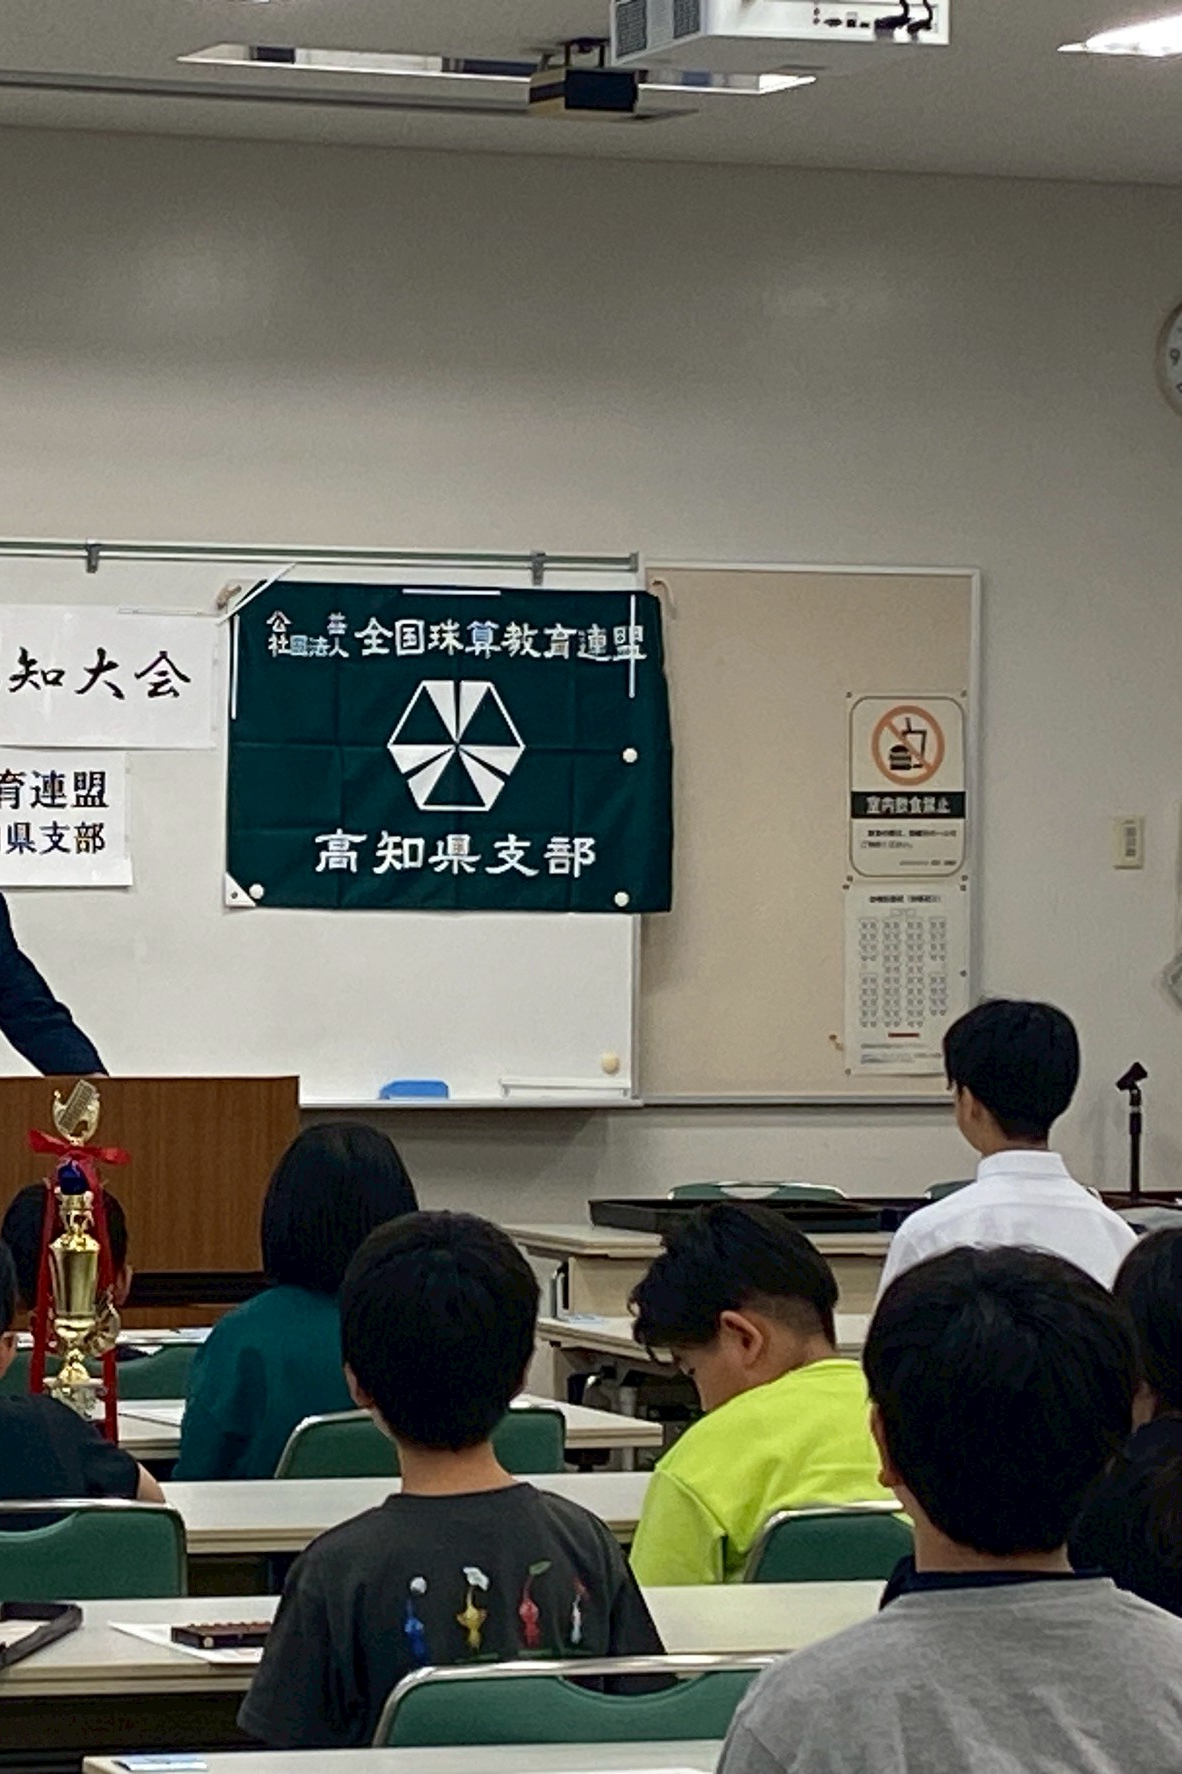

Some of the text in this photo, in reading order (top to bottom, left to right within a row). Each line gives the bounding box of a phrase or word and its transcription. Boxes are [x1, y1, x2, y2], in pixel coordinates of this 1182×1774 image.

[354, 616, 647, 662] 全国珠算教育連盟
[314, 828, 597, 878] 高知県支部
